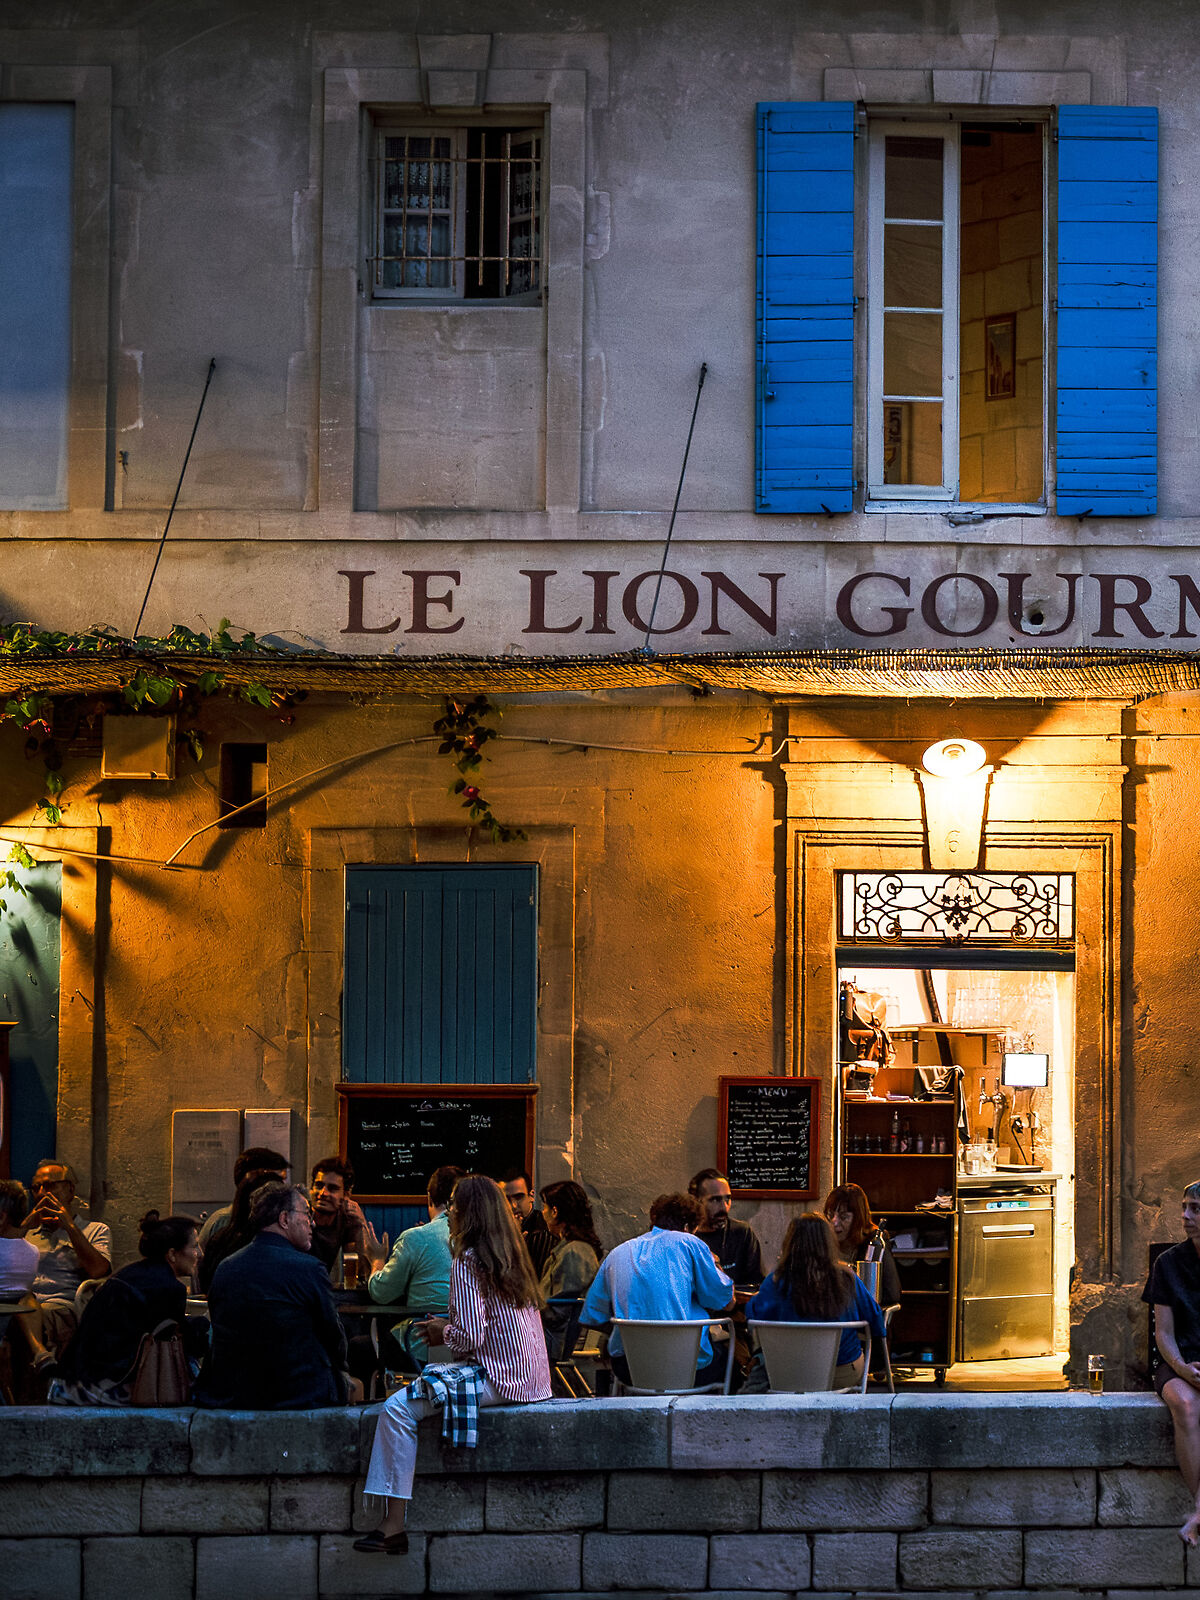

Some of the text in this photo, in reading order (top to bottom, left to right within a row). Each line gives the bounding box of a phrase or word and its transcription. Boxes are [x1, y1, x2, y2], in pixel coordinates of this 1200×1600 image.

[338, 570, 465, 634] LE
[519, 570, 787, 637] LION
[758, 1087, 788, 1097] MENU
